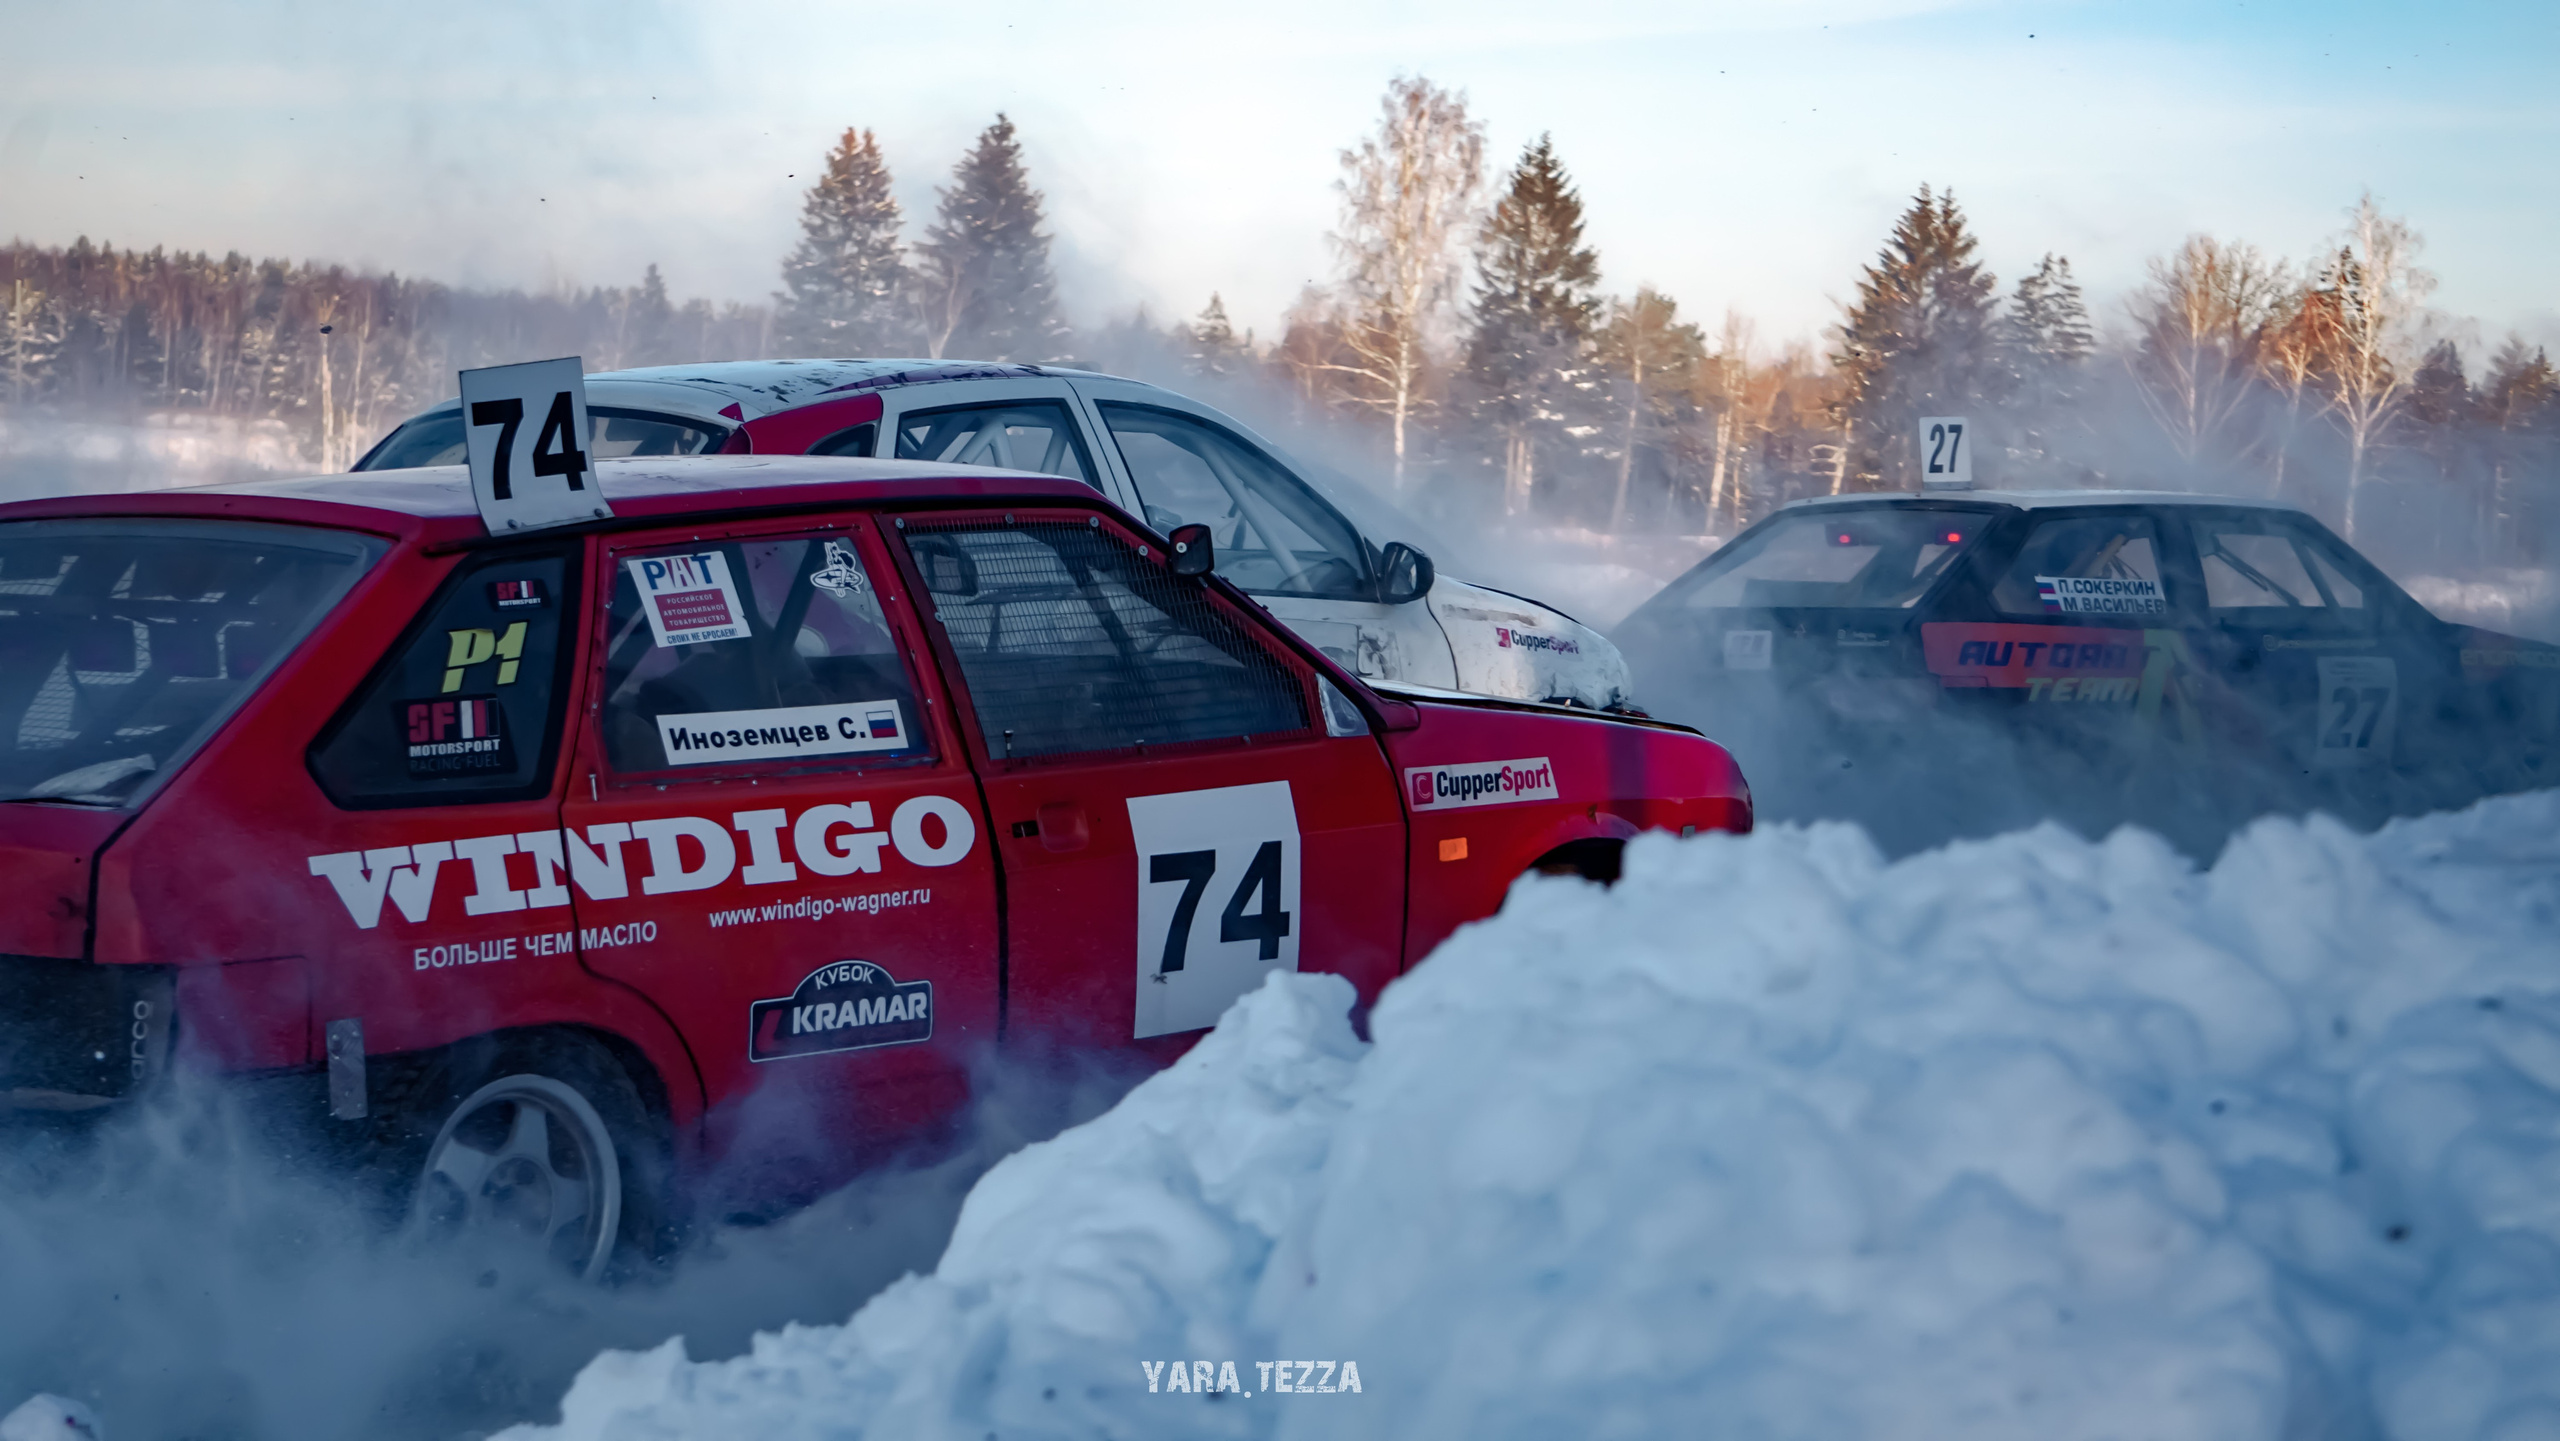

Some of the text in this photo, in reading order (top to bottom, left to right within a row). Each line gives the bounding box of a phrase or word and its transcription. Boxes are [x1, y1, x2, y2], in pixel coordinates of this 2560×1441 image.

[471, 391, 588, 500] 74
[1928, 424, 1963, 474] 27
[499, 598, 542, 606] MOTORSPORT
[667, 594, 714, 604] РОССИЙСКОЕ
[2058, 579, 2156, 595] П.СОКЕРКИН
[664, 604, 725, 616] АВТОМОБИЛЬНОЕ
[669, 615, 726, 626] ТОВАРИЩЕСТВО
[667, 628, 739, 644] СВОИХ НЕ БРОСАЕМ!
[442, 622, 529, 693] P1
[2026, 677, 2140, 701] TEAM
[668, 717, 866, 750] Иноземцев С.
[2322, 686, 2391, 748] 27
[409, 739, 500, 757] MOTORSPORT
[410, 753, 500, 771] RACING FUEL
[1436, 763, 1551, 801] CupperSport
[308, 795, 976, 929] WINDIGO
[709, 889, 931, 928] www.windigo-wagner.ru
[1150, 840, 1290, 973] 74
[414, 921, 657, 971] БОЛЬШЕ ЧЕМ МАСЛО
[815, 965, 875, 990] КУБОК
[792, 992, 928, 1034] KRAMAR
